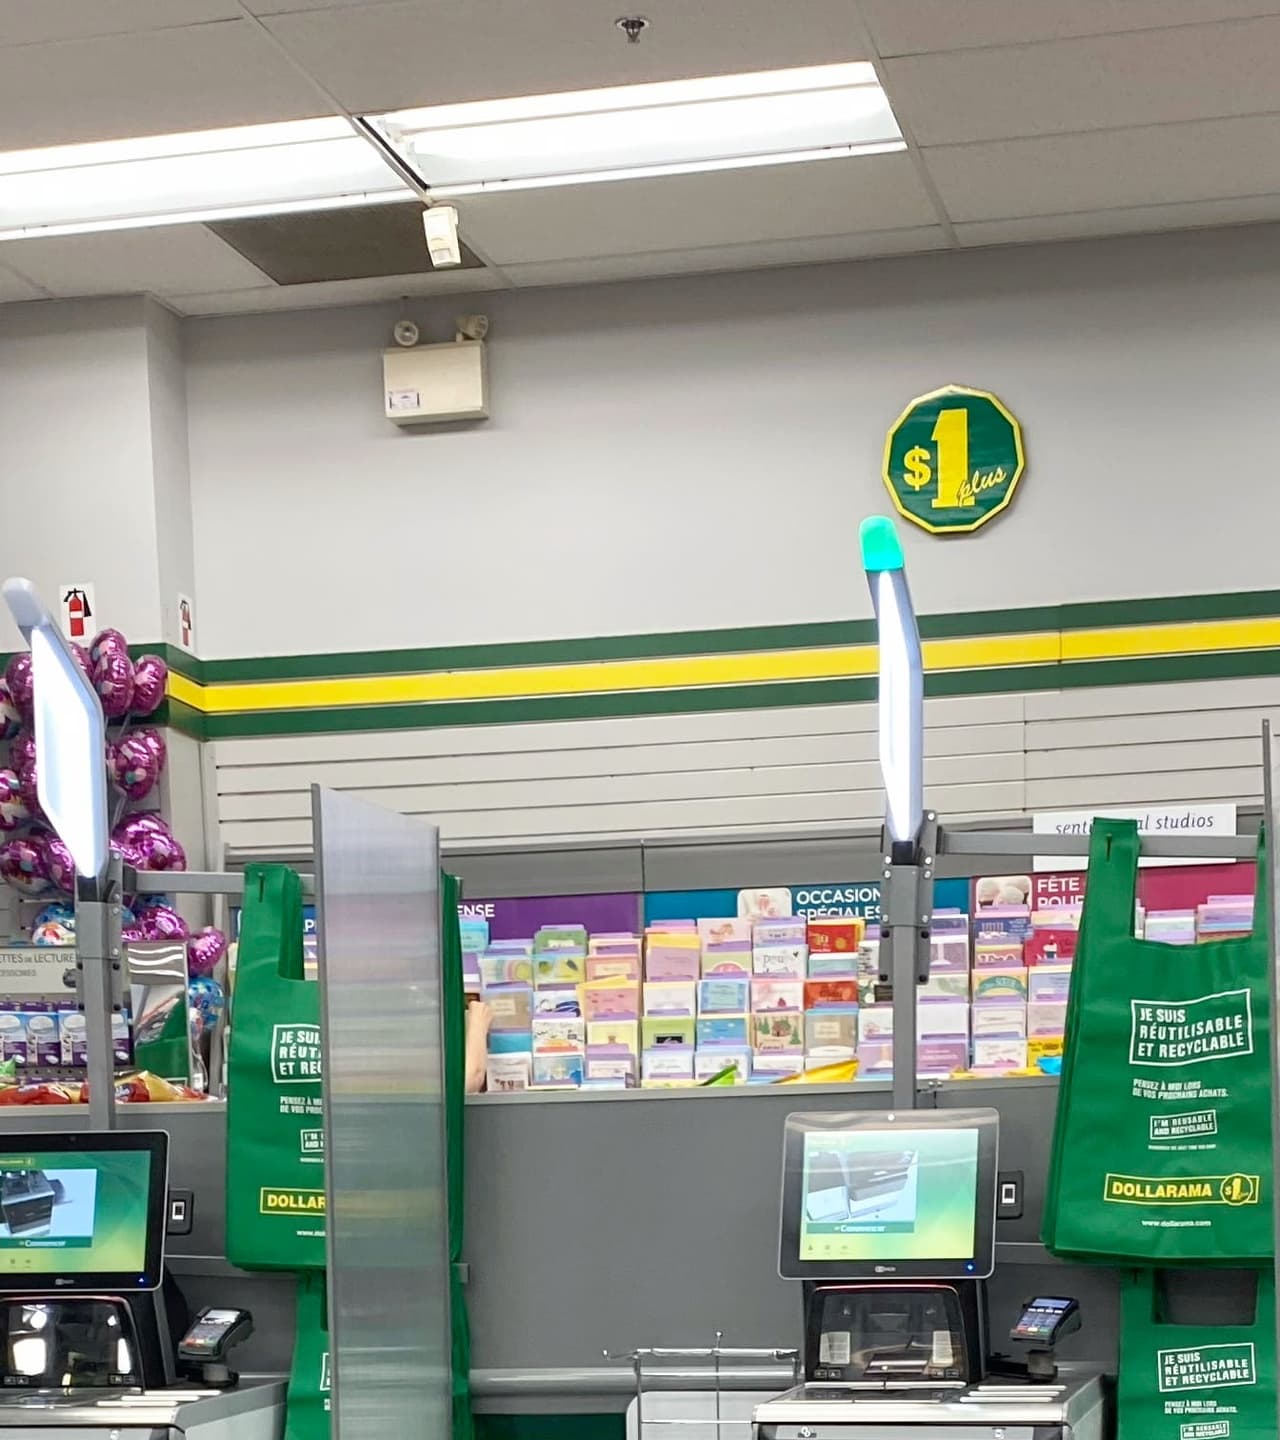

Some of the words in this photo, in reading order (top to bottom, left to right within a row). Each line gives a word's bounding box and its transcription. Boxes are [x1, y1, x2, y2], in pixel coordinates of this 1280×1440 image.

[904, 408, 975, 508] $1
[957, 467, 1007, 507] plus
[1056, 815, 1148, 834] sental
[1156, 812, 1214, 829] studios
[1037, 876, 1080, 893] FÊTE
[798, 888, 881, 903] OCCASION
[34, 953, 75, 963] LECTURE
[1140, 1008, 1153, 1021] JE
[1156, 1009, 1186, 1022] SUIS
[1140, 1015, 1243, 1039] RÉUTILISABLE
[279, 1031, 293, 1044] JE
[296, 1031, 320, 1044] SUI
[1138, 1043, 1154, 1057] ET
[1159, 1032, 1244, 1058] RECYCLABLE
[279, 1062, 295, 1075] ET
[1112, 1181, 1213, 1198] DOLLARAMA
[267, 1194, 326, 1208] DOLLAR
[1165, 1354, 1176, 1365] JE
[1178, 1352, 1200, 1364] SUIS
[1165, 1359, 1248, 1374] RÉUTILISABLE
[1165, 1377, 1178, 1386] ET
[1182, 1369, 1249, 1385] RECYCLABLE
